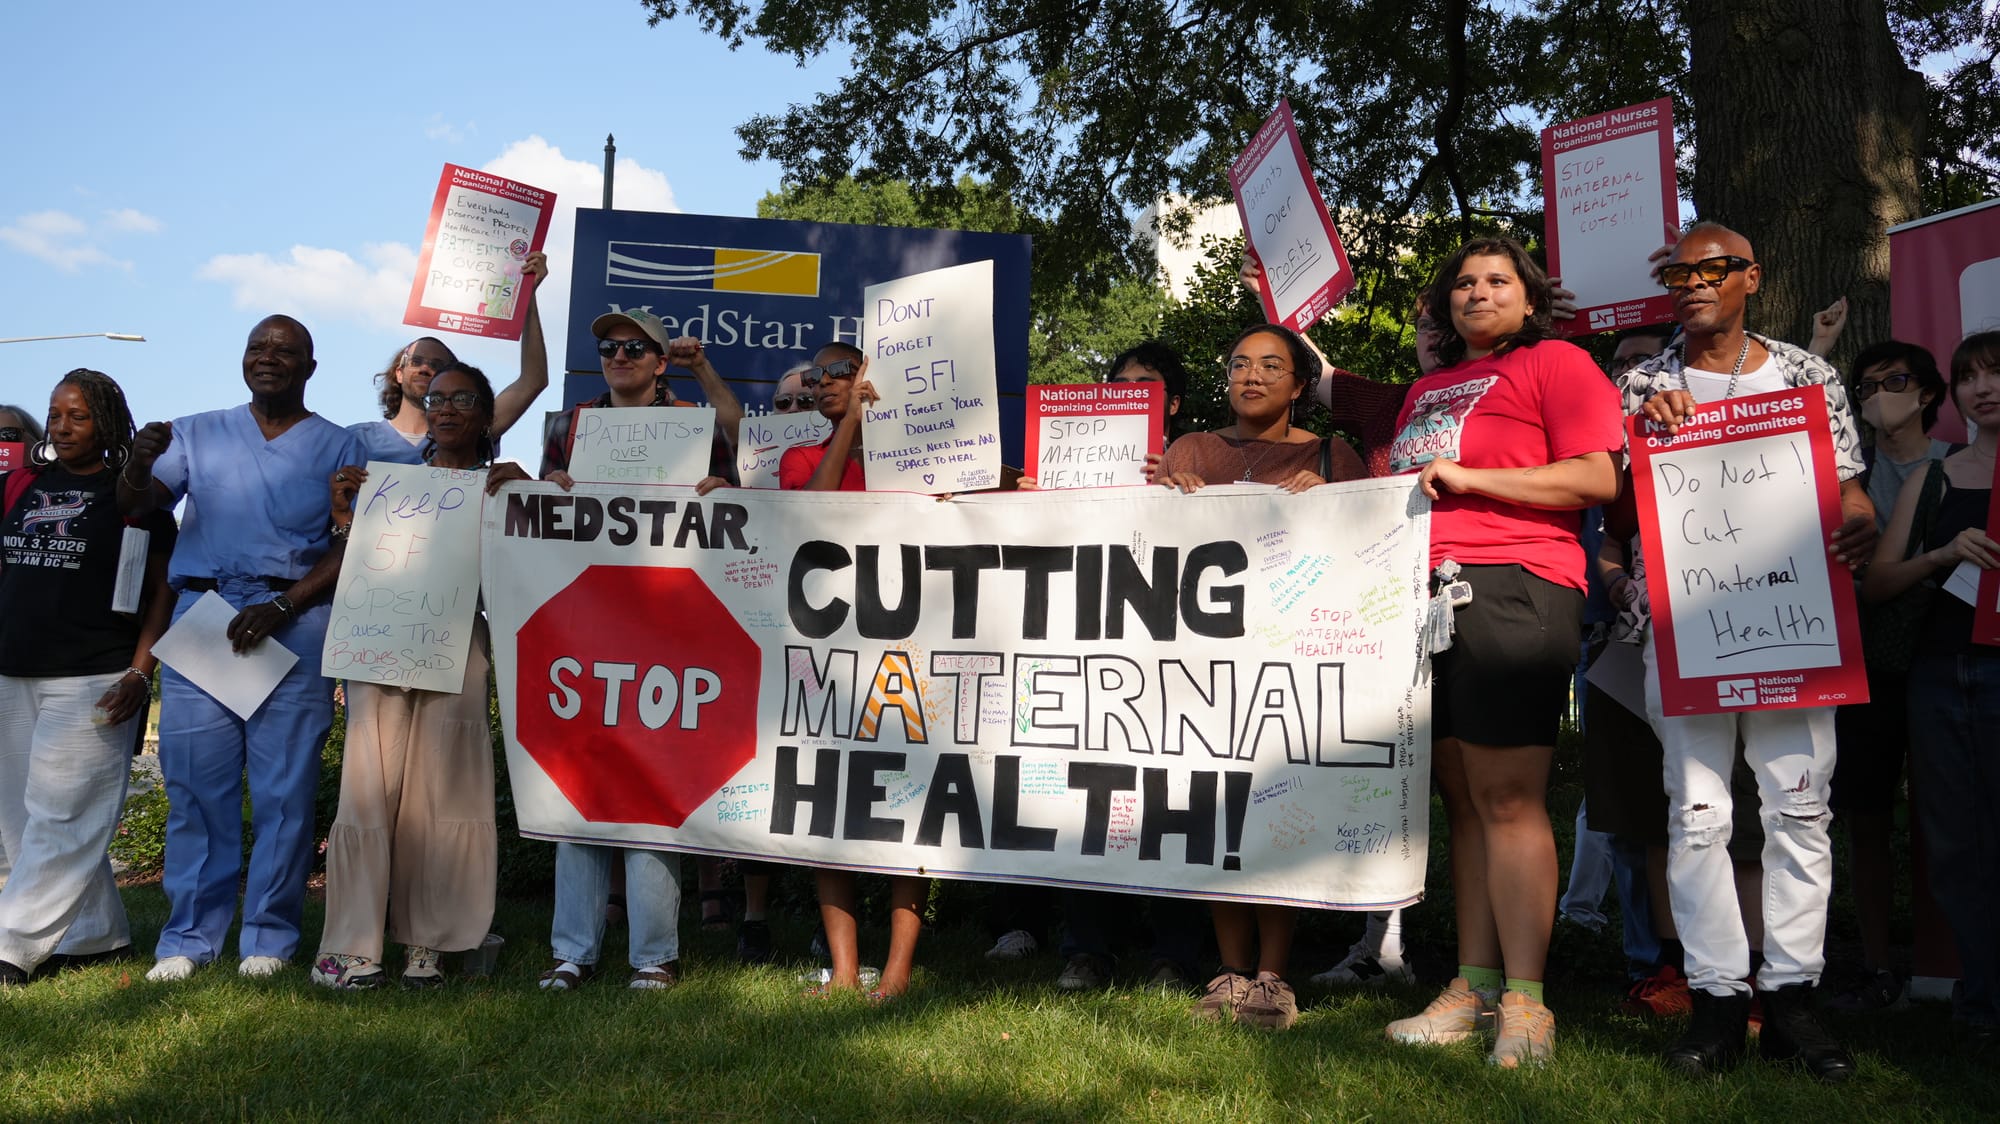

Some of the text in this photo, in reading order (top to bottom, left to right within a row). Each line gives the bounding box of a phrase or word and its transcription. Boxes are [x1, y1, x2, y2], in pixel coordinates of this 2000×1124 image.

[1553, 106, 1658, 140] National Nurses
[1554, 118, 1658, 150] Organizing Committee
[1234, 110, 1283, 176] National Nurses
[1238, 122, 1286, 184] Organizing Committee
[1562, 157, 1606, 181] STOP
[452, 177, 543, 206] Organizing Committee
[454, 168, 545, 200] National Nurses
[1560, 171, 1644, 200] MATERNAL
[1572, 188, 1630, 215] HEALTH
[492, 218, 528, 236] PROPER
[431, 270, 512, 297] PROFITS
[878, 298, 934, 326] DON'T
[1616, 302, 1646, 312] National
[1617, 310, 1641, 319] Nurses
[1618, 316, 1642, 326] United
[878, 336, 932, 359] FORGET
[1040, 388, 1149, 401] National Nurses
[866, 396, 983, 422] DON'T FORGET YOUR
[1040, 402, 1149, 413] Organizing Committee
[1645, 396, 1804, 434] Naonal Nurses
[582, 414, 690, 452] PATIENTS
[904, 418, 955, 436] DOULAS!
[1050, 419, 1106, 440] STOP
[1646, 414, 1806, 448] Organizing Committee
[610, 445, 648, 459] OVER
[868, 433, 996, 462] FAMILIES NEED TIME AND
[1042, 444, 1141, 464] MATERNAL
[742, 457, 778, 472] Wom
[896, 454, 976, 472] SPACE TO HEAL
[1042, 471, 1114, 488] HEALTH
[1659, 463, 1700, 496] Do
[504, 493, 758, 555] MEDSTAR,
[1682, 509, 1744, 544] Cut
[4, 536, 87, 552] NOV. 3, 2026
[1682, 556, 1800, 595] Maternal
[787, 540, 1248, 640] CUTTING
[1311, 608, 1352, 626] STOP
[1708, 604, 1824, 647] Health
[402, 622, 455, 648] The
[1295, 627, 1366, 640] MATERNAL
[1294, 640, 1382, 660] HEALTH CUTS!
[935, 656, 994, 672] PATIENTS
[1758, 674, 1804, 686] National
[1760, 684, 1796, 694] Nurses
[548, 656, 722, 730] STOP
[1760, 693, 1797, 704] United
[780, 645, 1394, 768] MATERNAL
[721, 784, 769, 798] PATIENTS
[717, 800, 748, 812] OVER
[770, 746, 1252, 870] HEALTH!
[1337, 822, 1386, 838] Keep 5F
